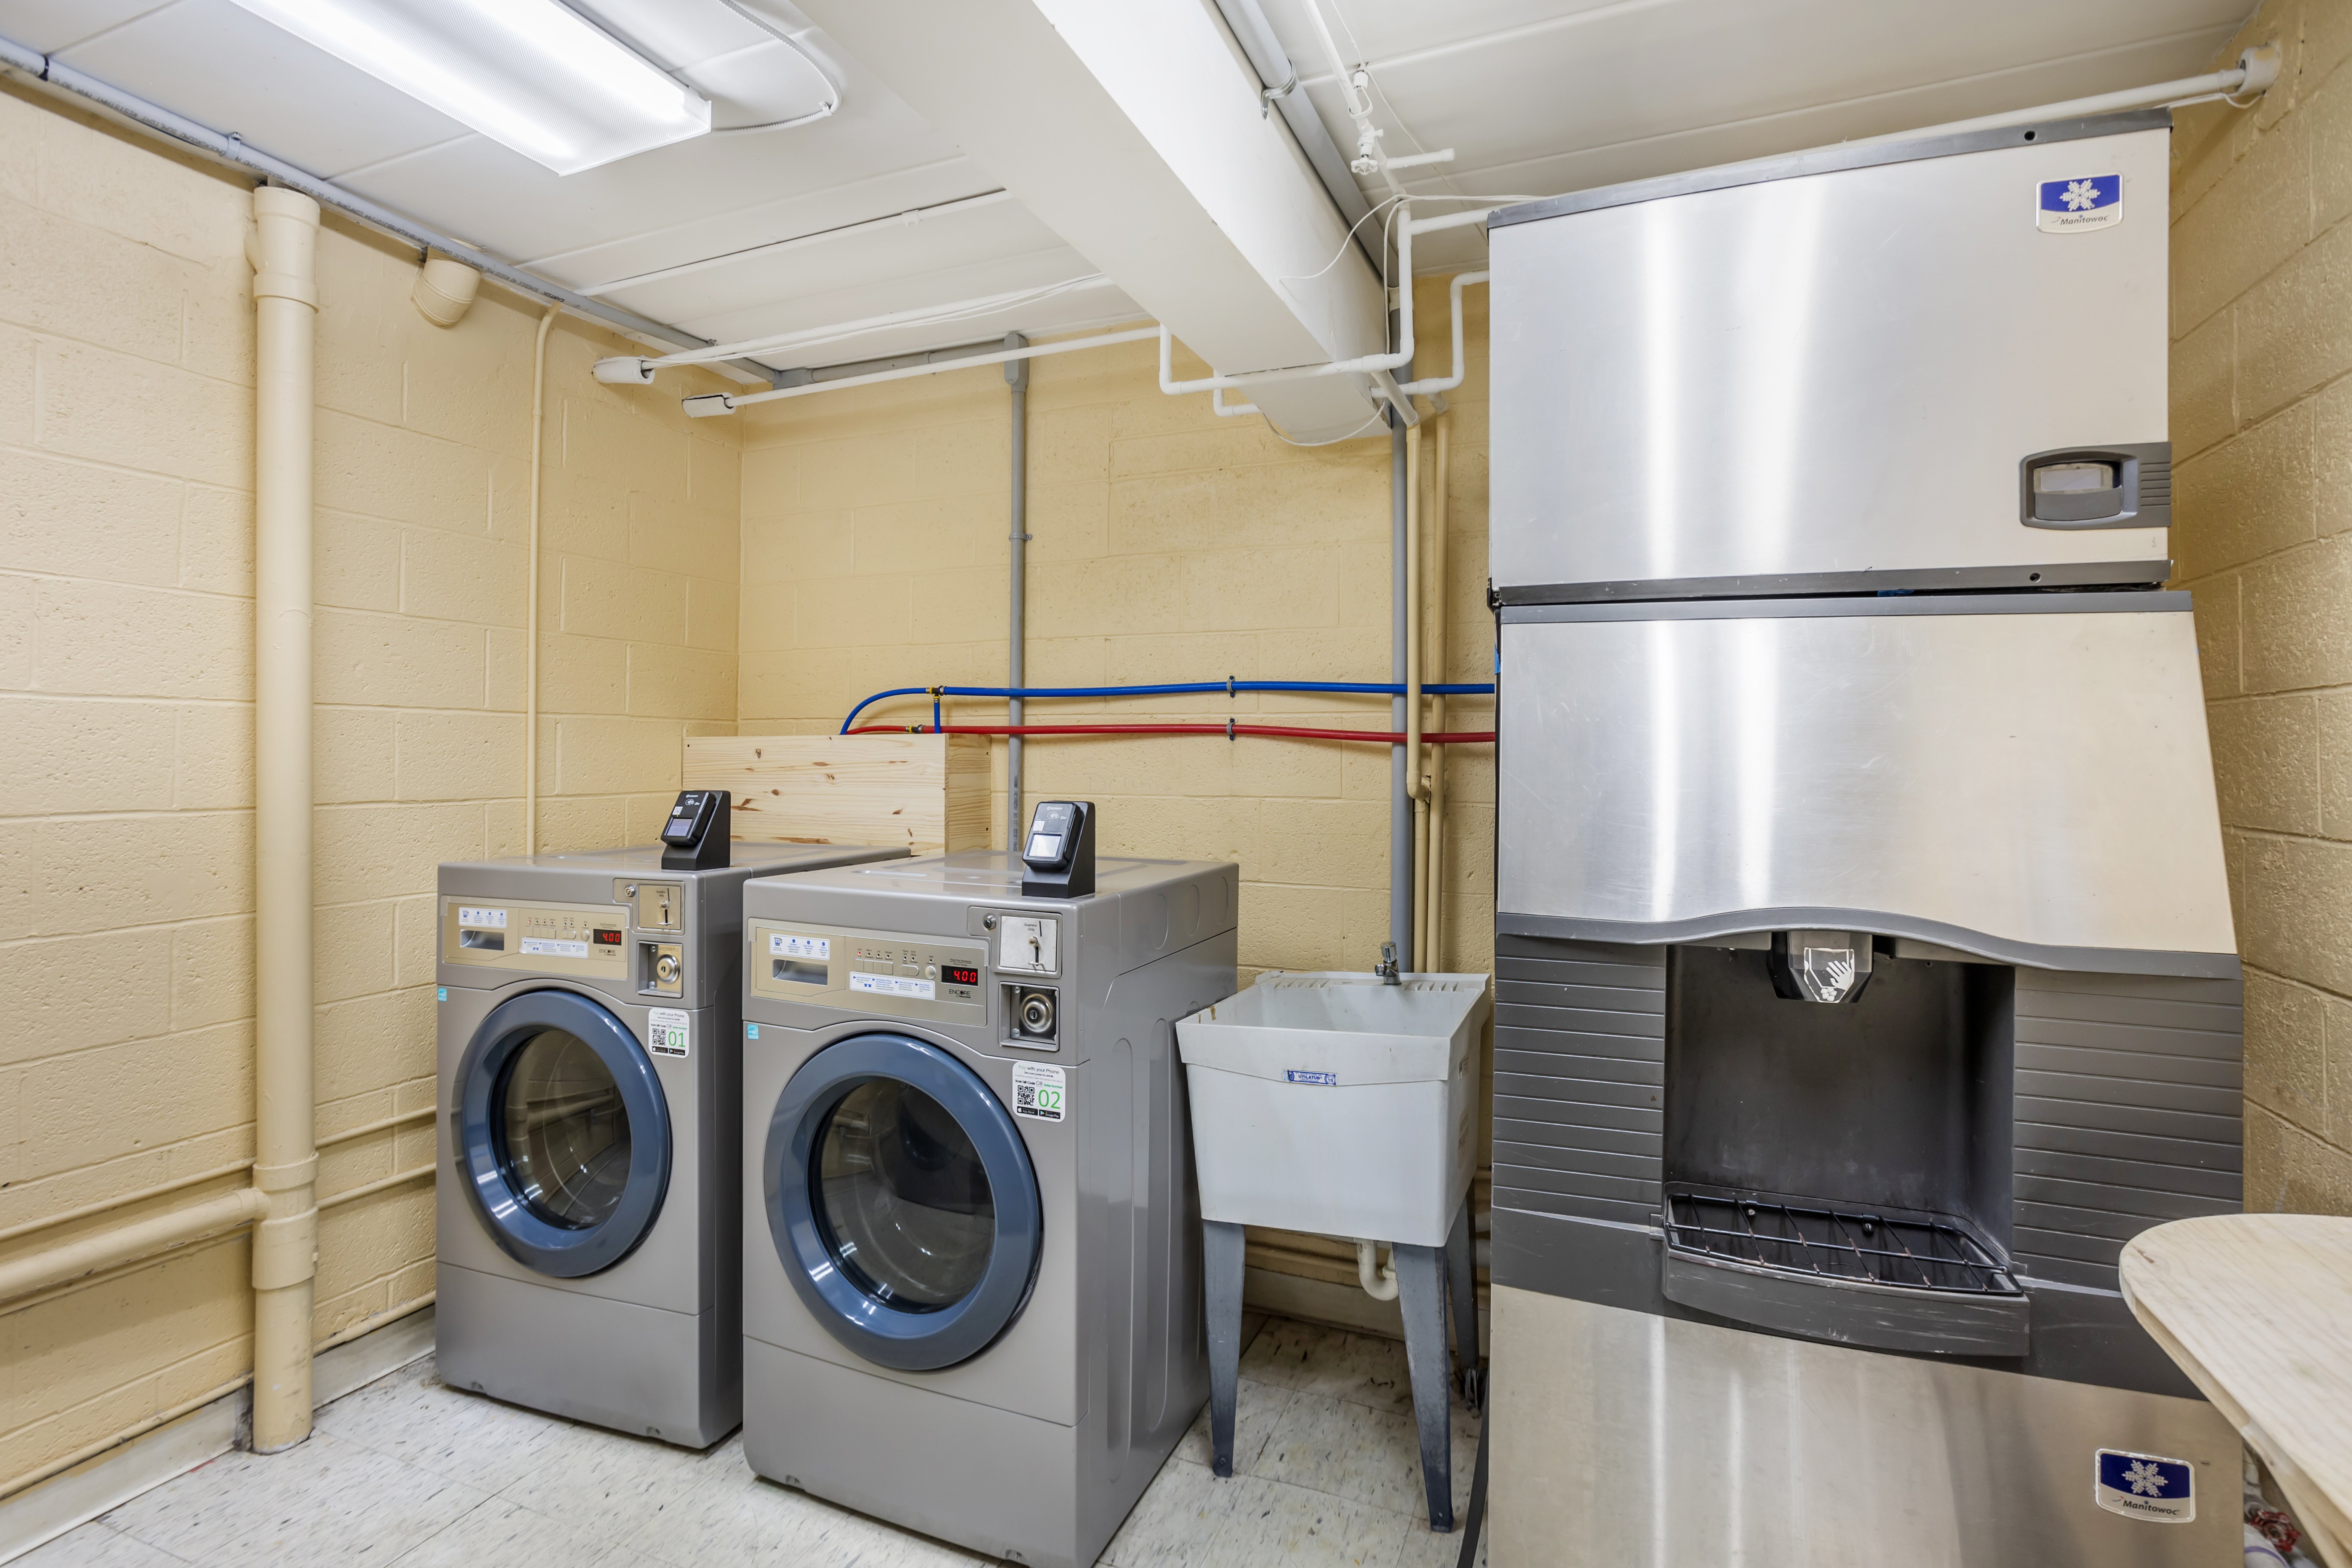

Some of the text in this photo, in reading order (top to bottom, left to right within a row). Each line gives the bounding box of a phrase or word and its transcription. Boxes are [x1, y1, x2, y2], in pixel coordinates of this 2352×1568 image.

[244, 159, 286, 181] ABOVEGROUND
[336, 200, 364, 216] CONFORMS
[2060, 215, 2108, 226] Manitowoc
[954, 971, 976, 982] 4.00
[668, 1031, 685, 1047] 01
[1038, 1090, 1060, 1109] 02
[2123, 1500, 2177, 1515] Manitowoc
